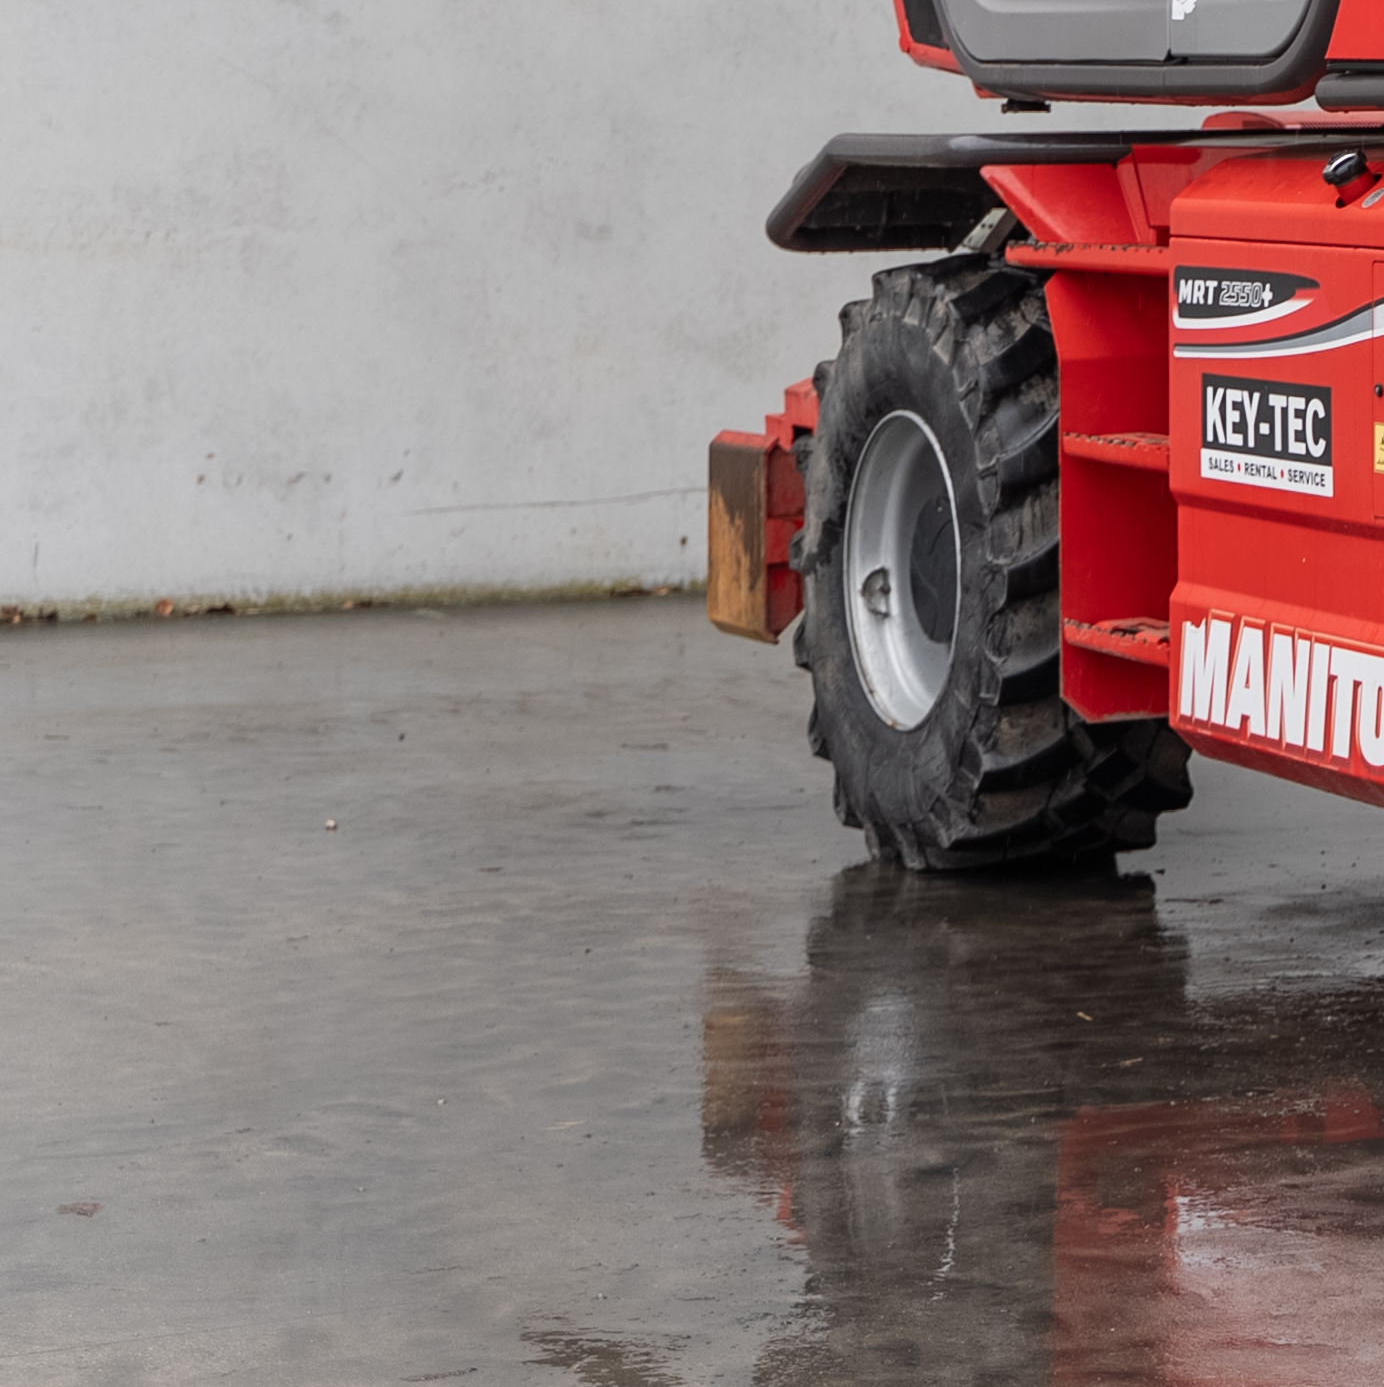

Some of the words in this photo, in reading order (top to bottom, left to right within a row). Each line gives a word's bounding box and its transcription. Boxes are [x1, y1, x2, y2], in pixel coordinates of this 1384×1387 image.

[1178, 279, 1218, 306] MRT
[1207, 386, 1326, 458] KEY-TEC
[1209, 457, 1234, 473] SALES
[1244, 462, 1277, 480] RENTAL
[1287, 469, 1325, 487] SERVICE
